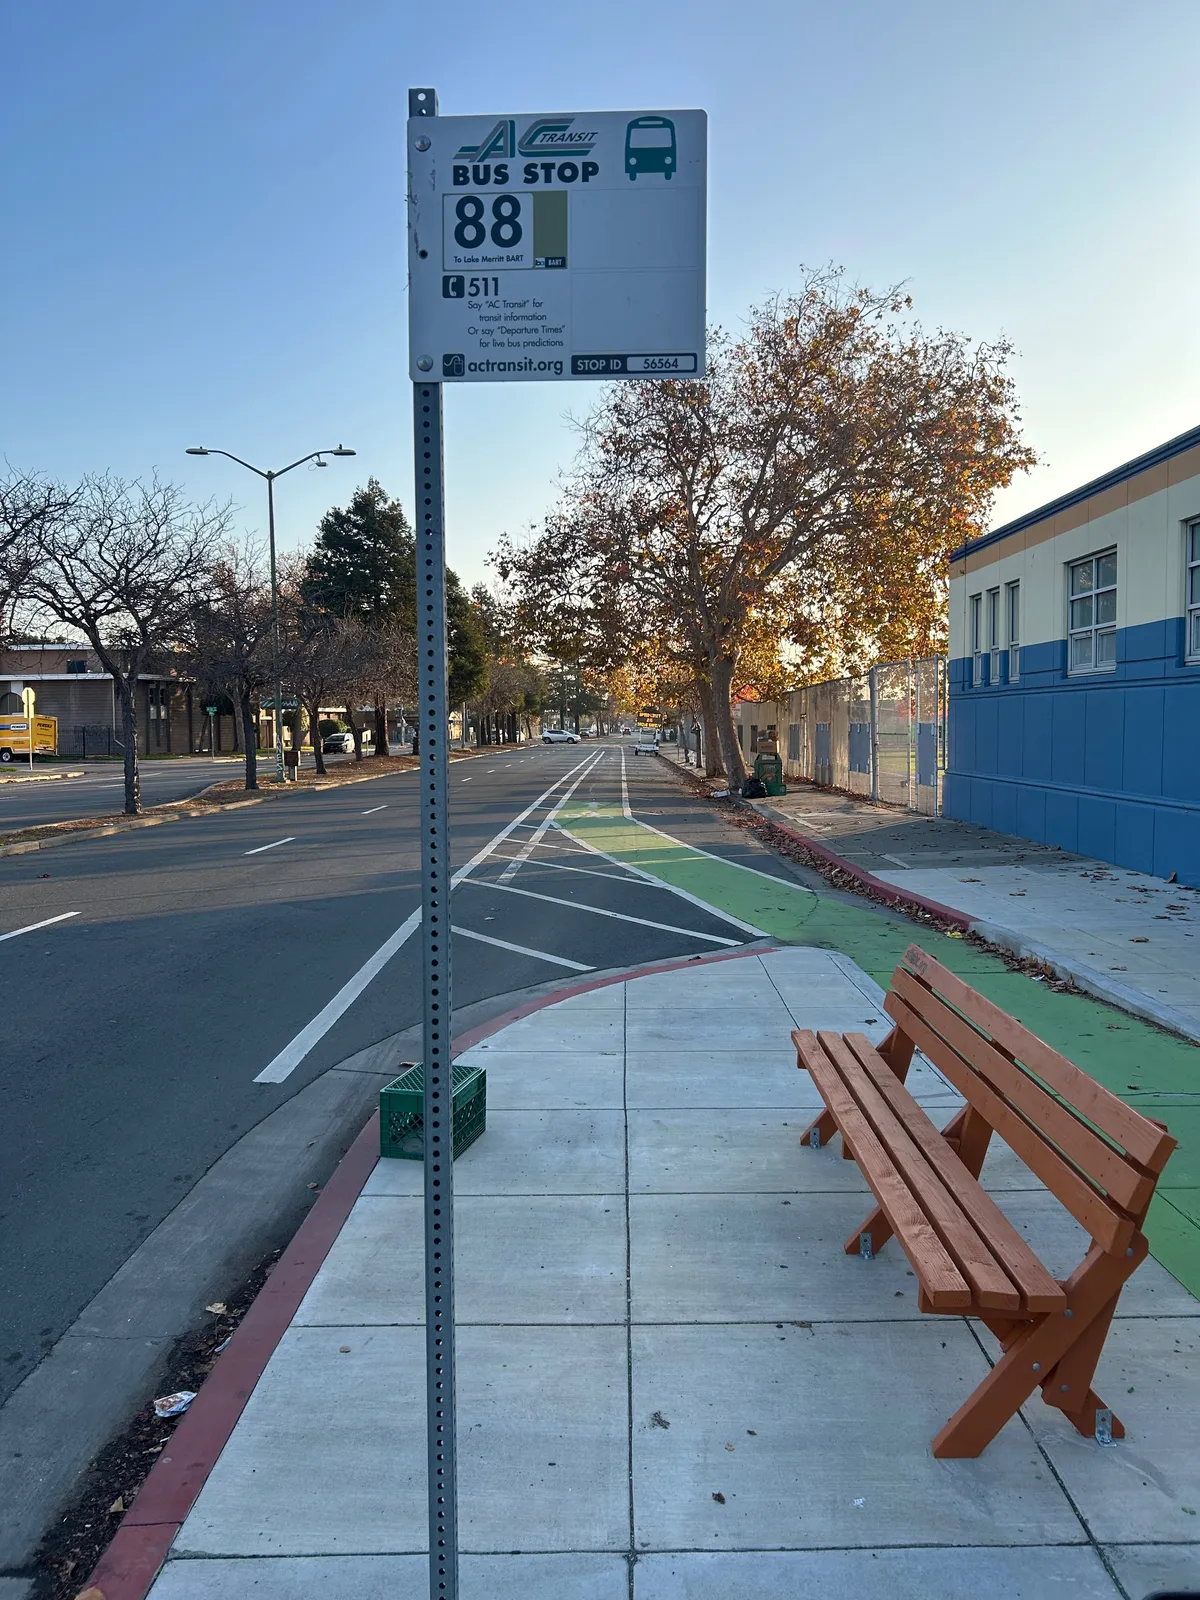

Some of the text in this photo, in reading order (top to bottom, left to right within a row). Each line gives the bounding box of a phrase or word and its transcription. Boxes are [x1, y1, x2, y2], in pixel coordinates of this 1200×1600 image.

[539, 132, 599, 143] TRANSIT
[452, 161, 600, 186] BUS STOP
[454, 194, 523, 249] 88
[464, 255, 479, 263] Lake
[481, 255, 505, 263] Merritt
[506, 254, 524, 262] BART
[467, 277, 499, 297] 511
[467, 301, 483, 311] Say
[532, 298, 544, 308] for
[479, 312, 547, 322] transit information
[467, 326, 479, 335] Or
[481, 328, 495, 337] say
[479, 337, 564, 349] for live bus predictions
[467, 356, 564, 375] actransit.org
[577, 358, 679, 371] STOP ID 56564
